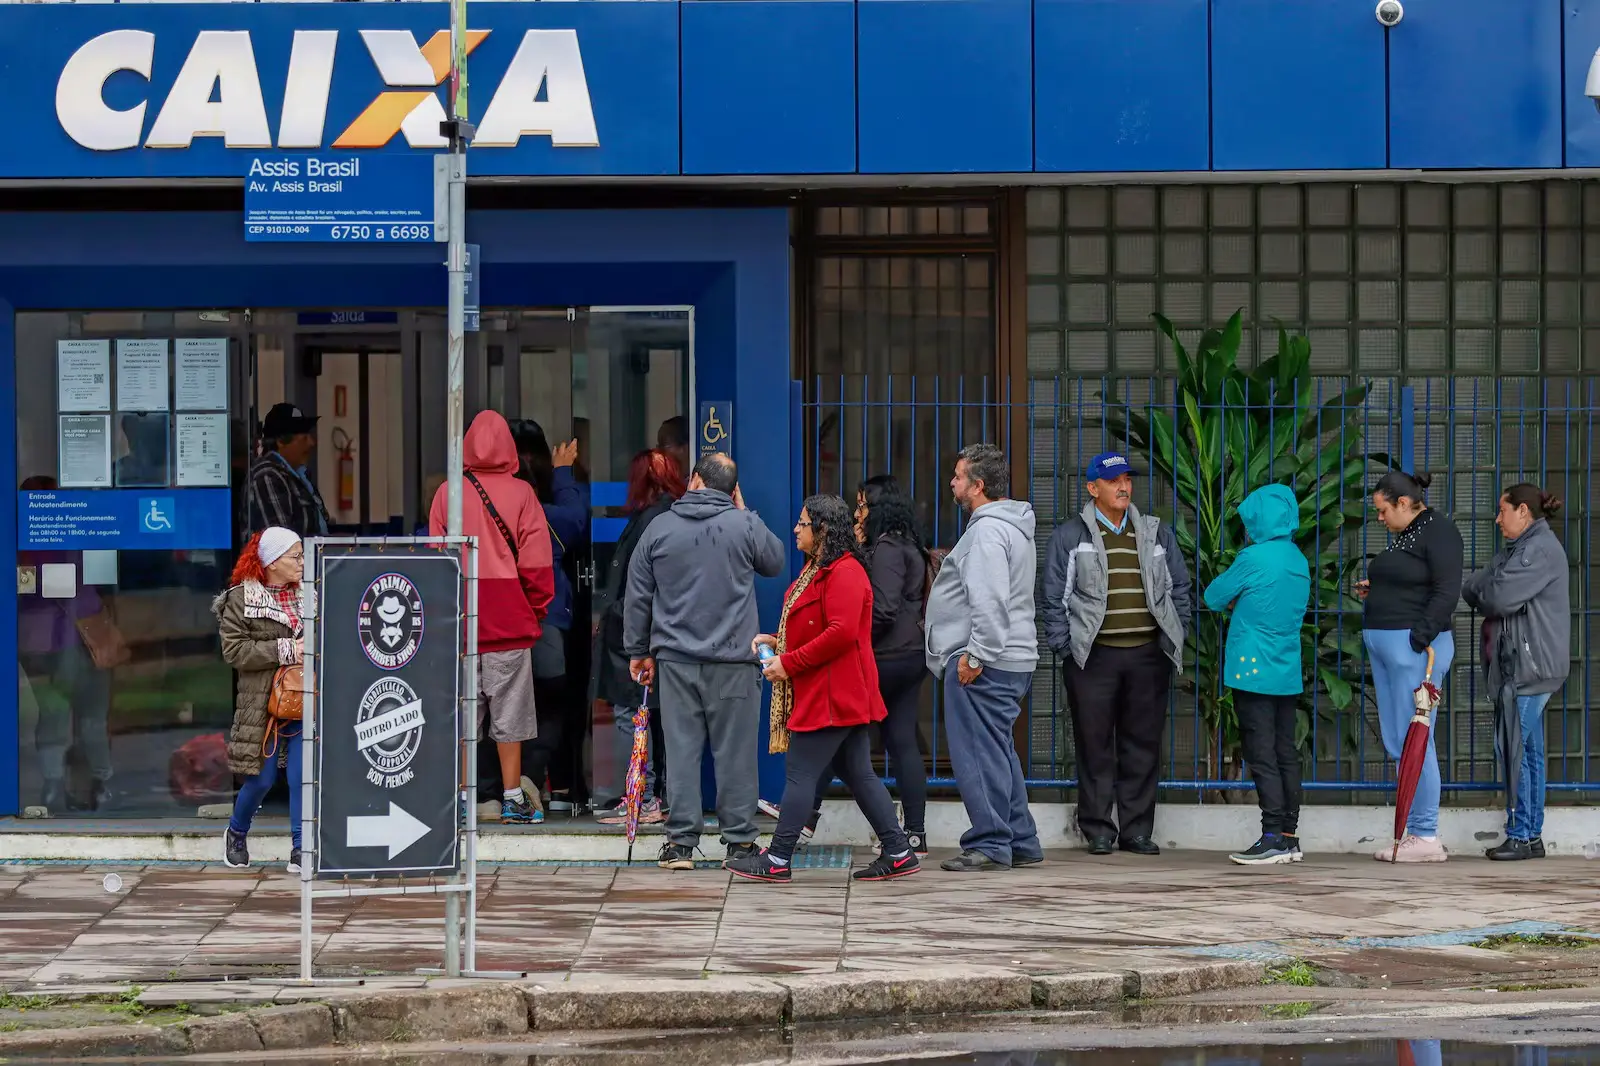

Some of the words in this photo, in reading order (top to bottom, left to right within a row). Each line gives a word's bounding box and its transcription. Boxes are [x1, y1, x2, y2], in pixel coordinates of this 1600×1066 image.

[55, 28, 600, 151] CAIXA
[249, 158, 300, 177] Assis
[307, 158, 360, 177] Brasil
[249, 181, 268, 193] Av.
[272, 181, 305, 193] Assis
[309, 181, 343, 193] Brasil
[249, 226, 265, 234] CEP
[266, 226, 310, 234] 91010-004
[331, 226, 370, 239] 6750
[376, 229, 385, 239] a
[390, 226, 429, 239] 6698
[97, 529, 120, 537] segunda
[372, 575, 412, 597] PRIMUS
[412, 617, 422, 626] RS
[366, 641, 397, 667] BARBER
[397, 638, 416, 665] SHOP
[360, 720, 392, 741] OUTRO
[394, 709, 419, 728] LADO
[377, 747, 412, 768] CORPORAL
[366, 767, 385, 787] BODY
[385, 766, 415, 788] PIERCING
